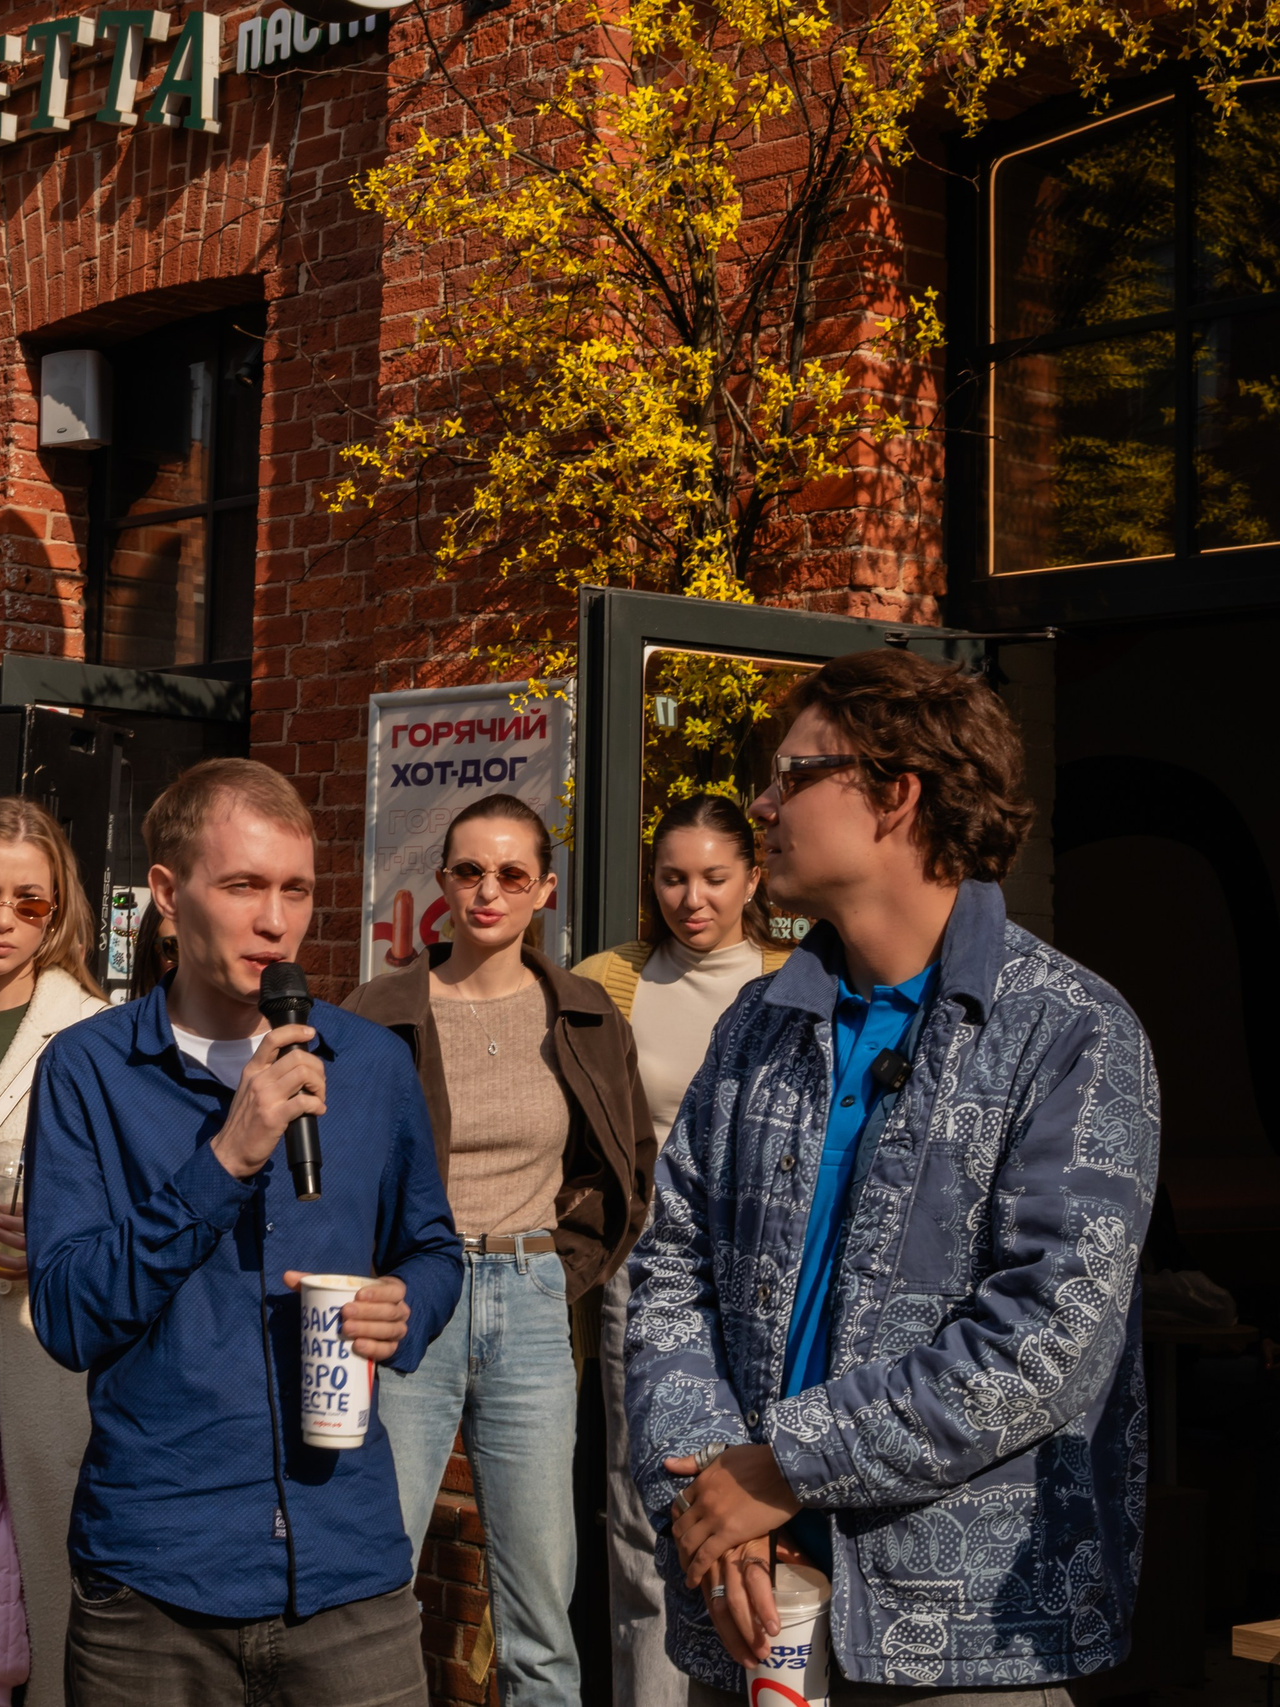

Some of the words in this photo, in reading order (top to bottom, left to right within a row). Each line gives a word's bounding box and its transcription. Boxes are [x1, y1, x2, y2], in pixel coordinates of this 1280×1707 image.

[236, 8, 376, 74] ПАС
[391, 708, 547, 749] ГОРЯЧИЙ
[390, 756, 527, 788] ХОТ-ДОГ
[301, 1363, 348, 1390] БРО
[758, 1657, 807, 1670] АУЗ
[770, 1643, 813, 1657] ФЕ
